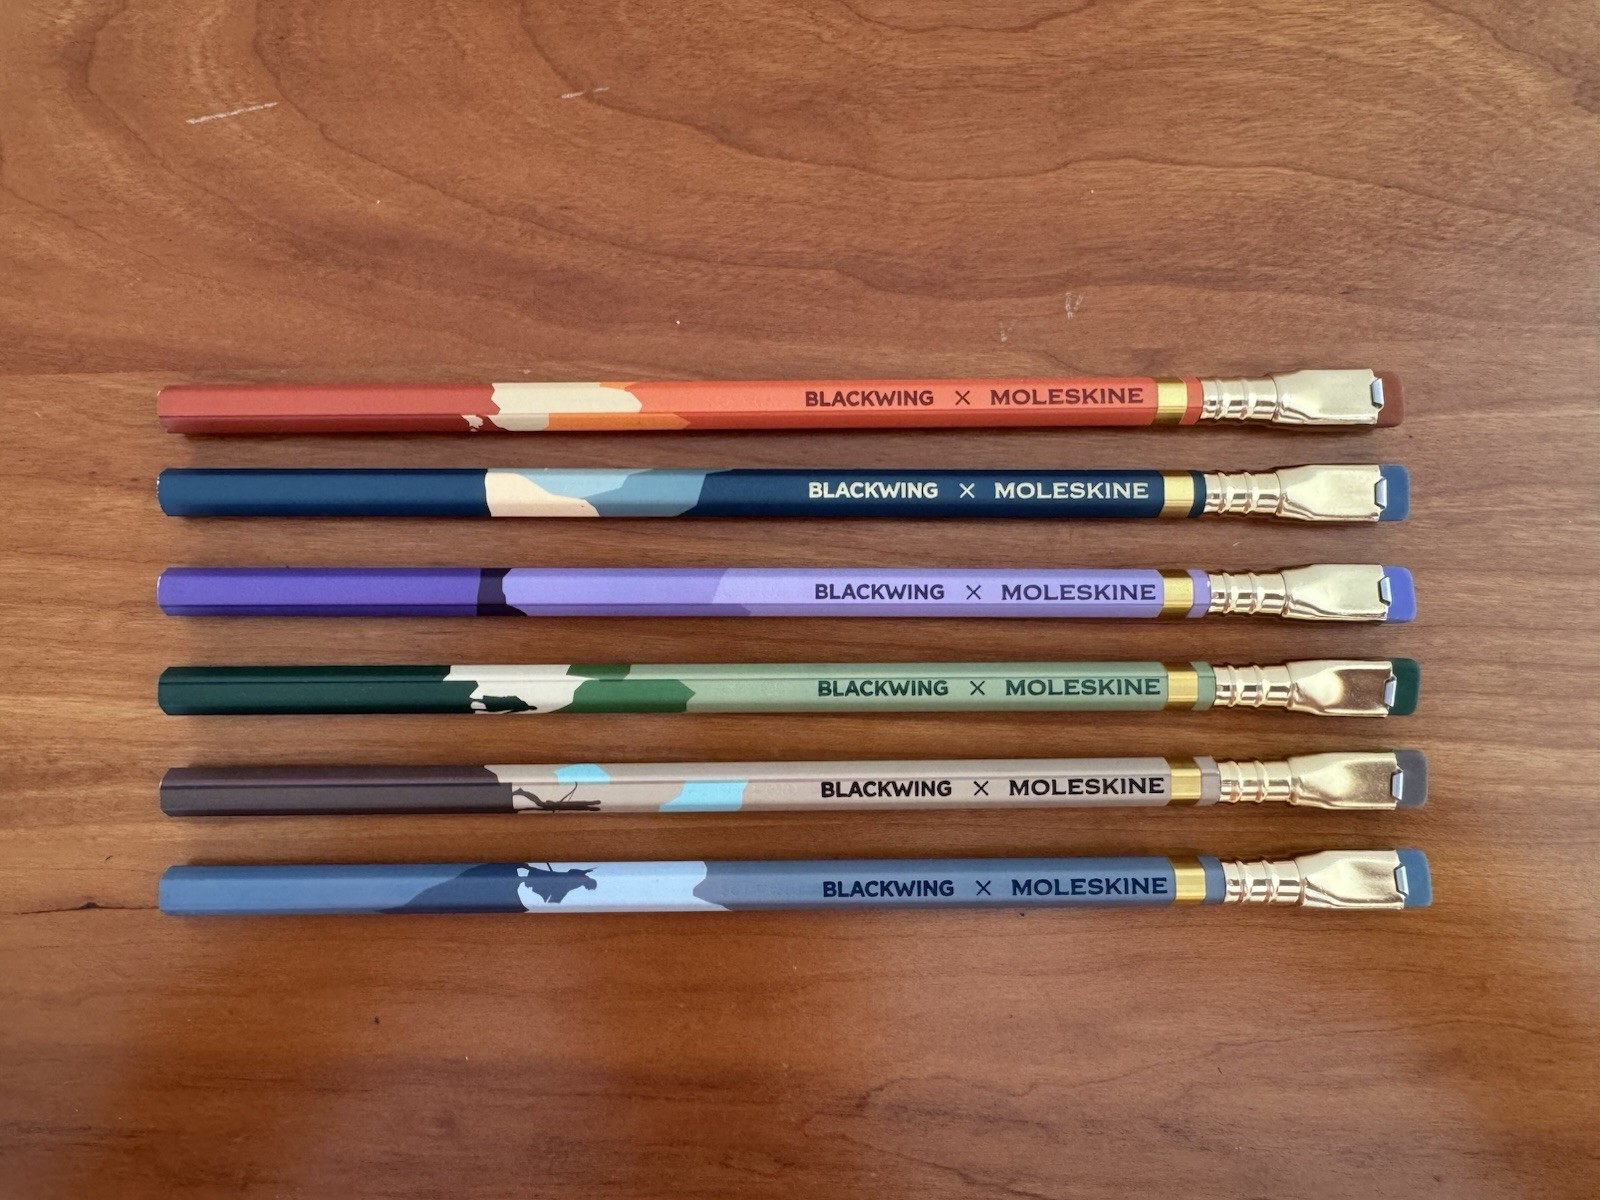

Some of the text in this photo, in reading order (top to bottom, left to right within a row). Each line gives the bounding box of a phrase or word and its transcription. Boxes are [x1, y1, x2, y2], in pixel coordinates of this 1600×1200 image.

[806, 390, 933, 407] BLACKWING
[991, 388, 1143, 405] MOLESKINE
[809, 482, 938, 498] BLACKWING
[995, 482, 1148, 499] MOLESKINE
[816, 584, 944, 600] BLACKWING
[1002, 584, 1155, 600] MOLESKINE
[818, 680, 948, 696] BLACKWING
[1006, 679, 1160, 695] MOLESKINE
[821, 781, 951, 798] BLACKWING
[1010, 778, 1164, 795] MOLESKINE
[823, 880, 954, 897] BLACKWING
[1012, 877, 1167, 895] MOLESKINE
